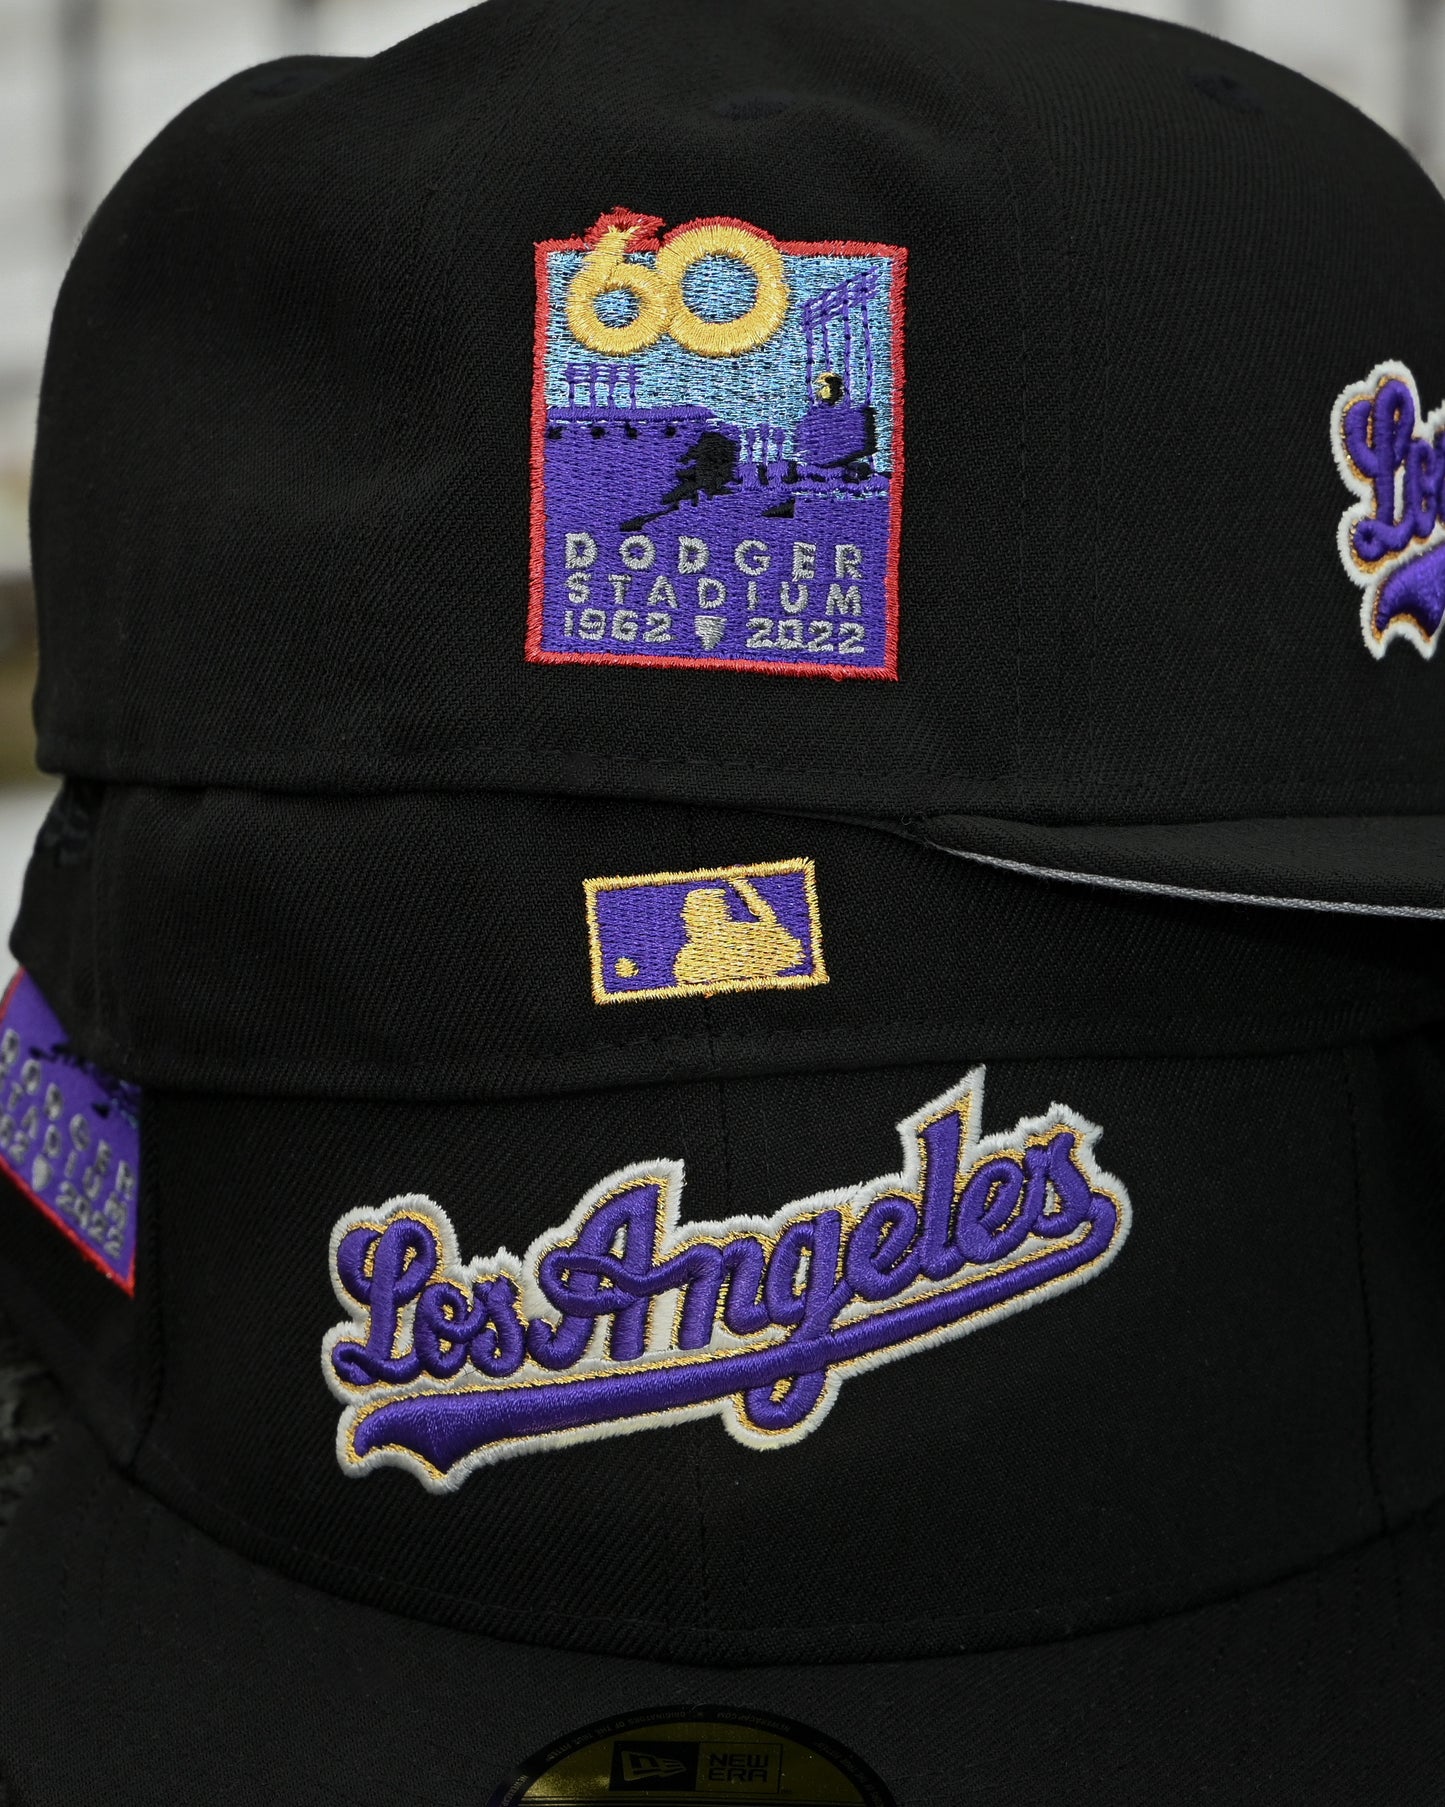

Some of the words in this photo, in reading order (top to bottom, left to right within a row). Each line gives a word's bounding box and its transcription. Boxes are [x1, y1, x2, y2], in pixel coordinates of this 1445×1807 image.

[566, 222, 789, 357] 60
[1346, 376, 1445, 564] Lo
[564, 531, 863, 580] DODGER
[566, 571, 863, 616] STADIUM
[564, 607, 676, 642] 1962
[746, 615, 866, 655] 2022
[2, 1027, 135, 1200] DODGER
[328, 1212, 527, 1388] Los
[526, 1097, 1118, 1434] Angeles
[708, 1768, 768, 1783] ERA
[709, 1752, 769, 1768] NEW
